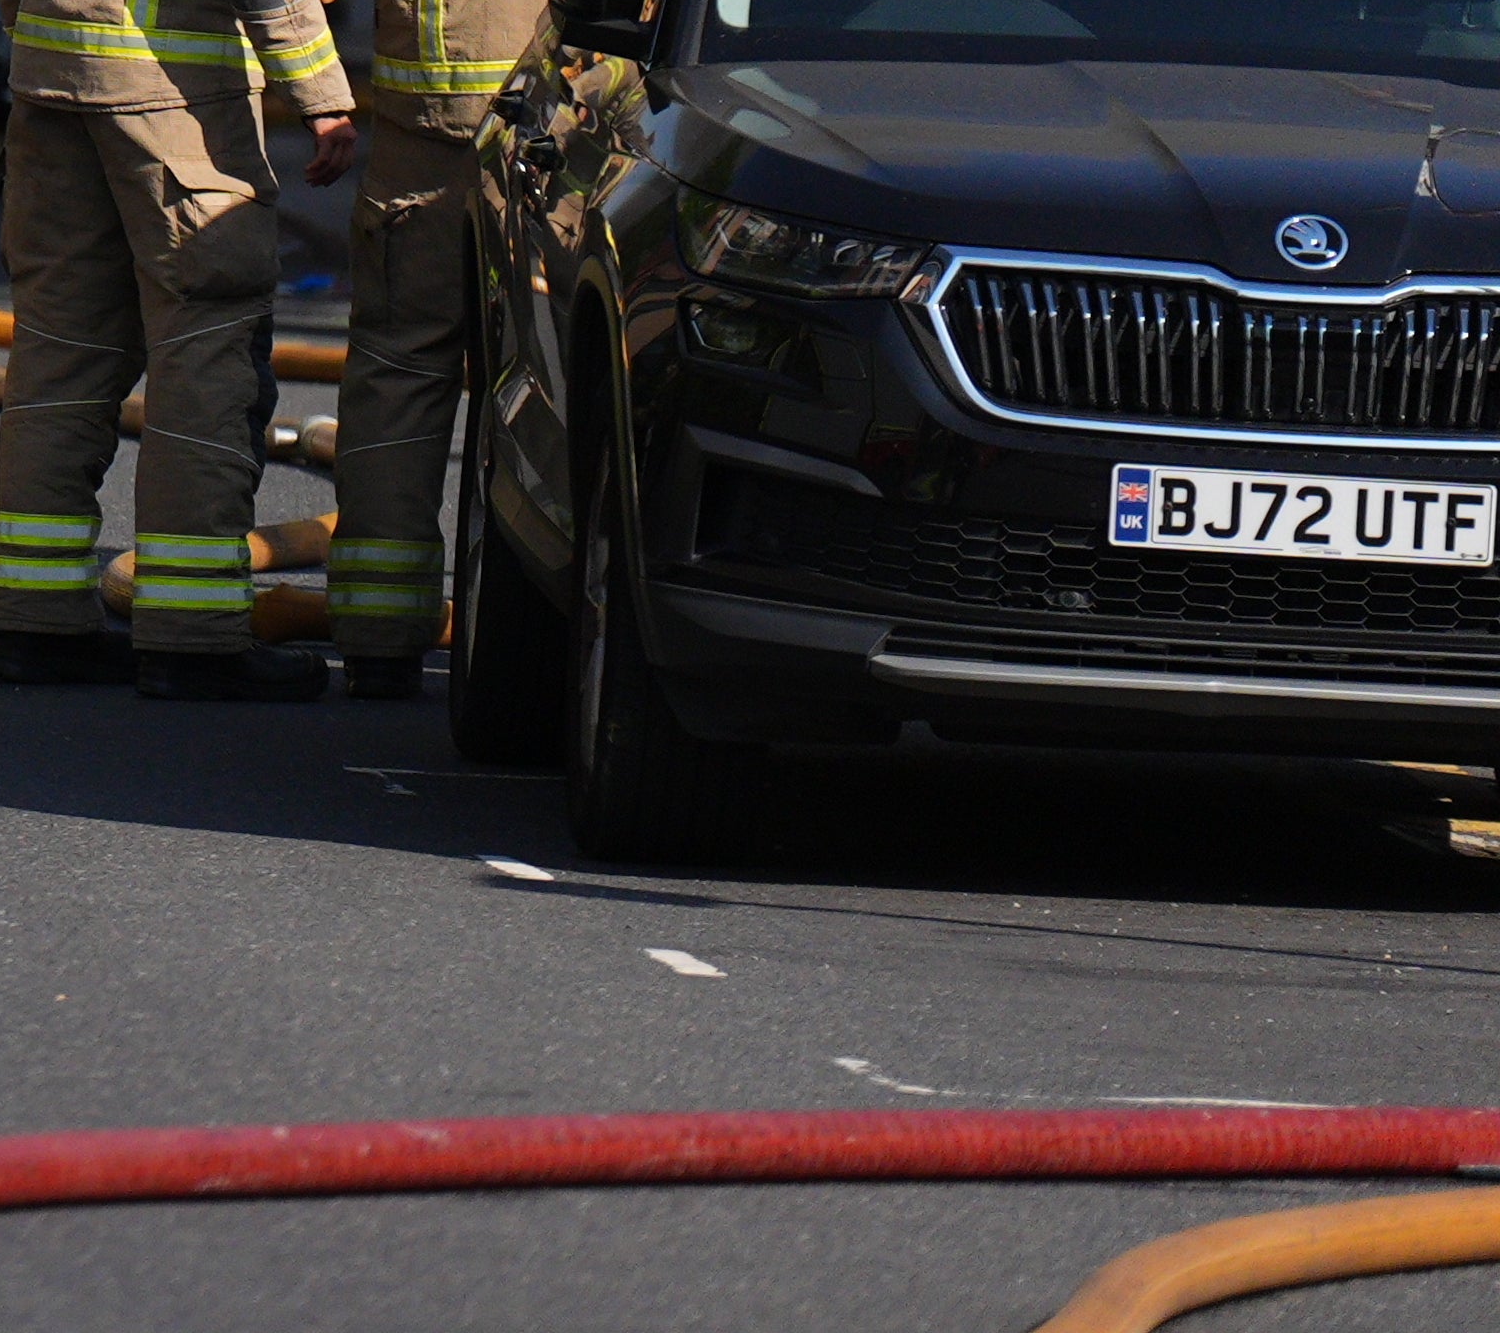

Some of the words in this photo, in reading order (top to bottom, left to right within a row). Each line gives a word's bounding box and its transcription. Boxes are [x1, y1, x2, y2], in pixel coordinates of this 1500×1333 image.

[1119, 513, 1144, 530] UK
[1157, 477, 1334, 545] BJ72
[1355, 488, 1485, 552] UTF
